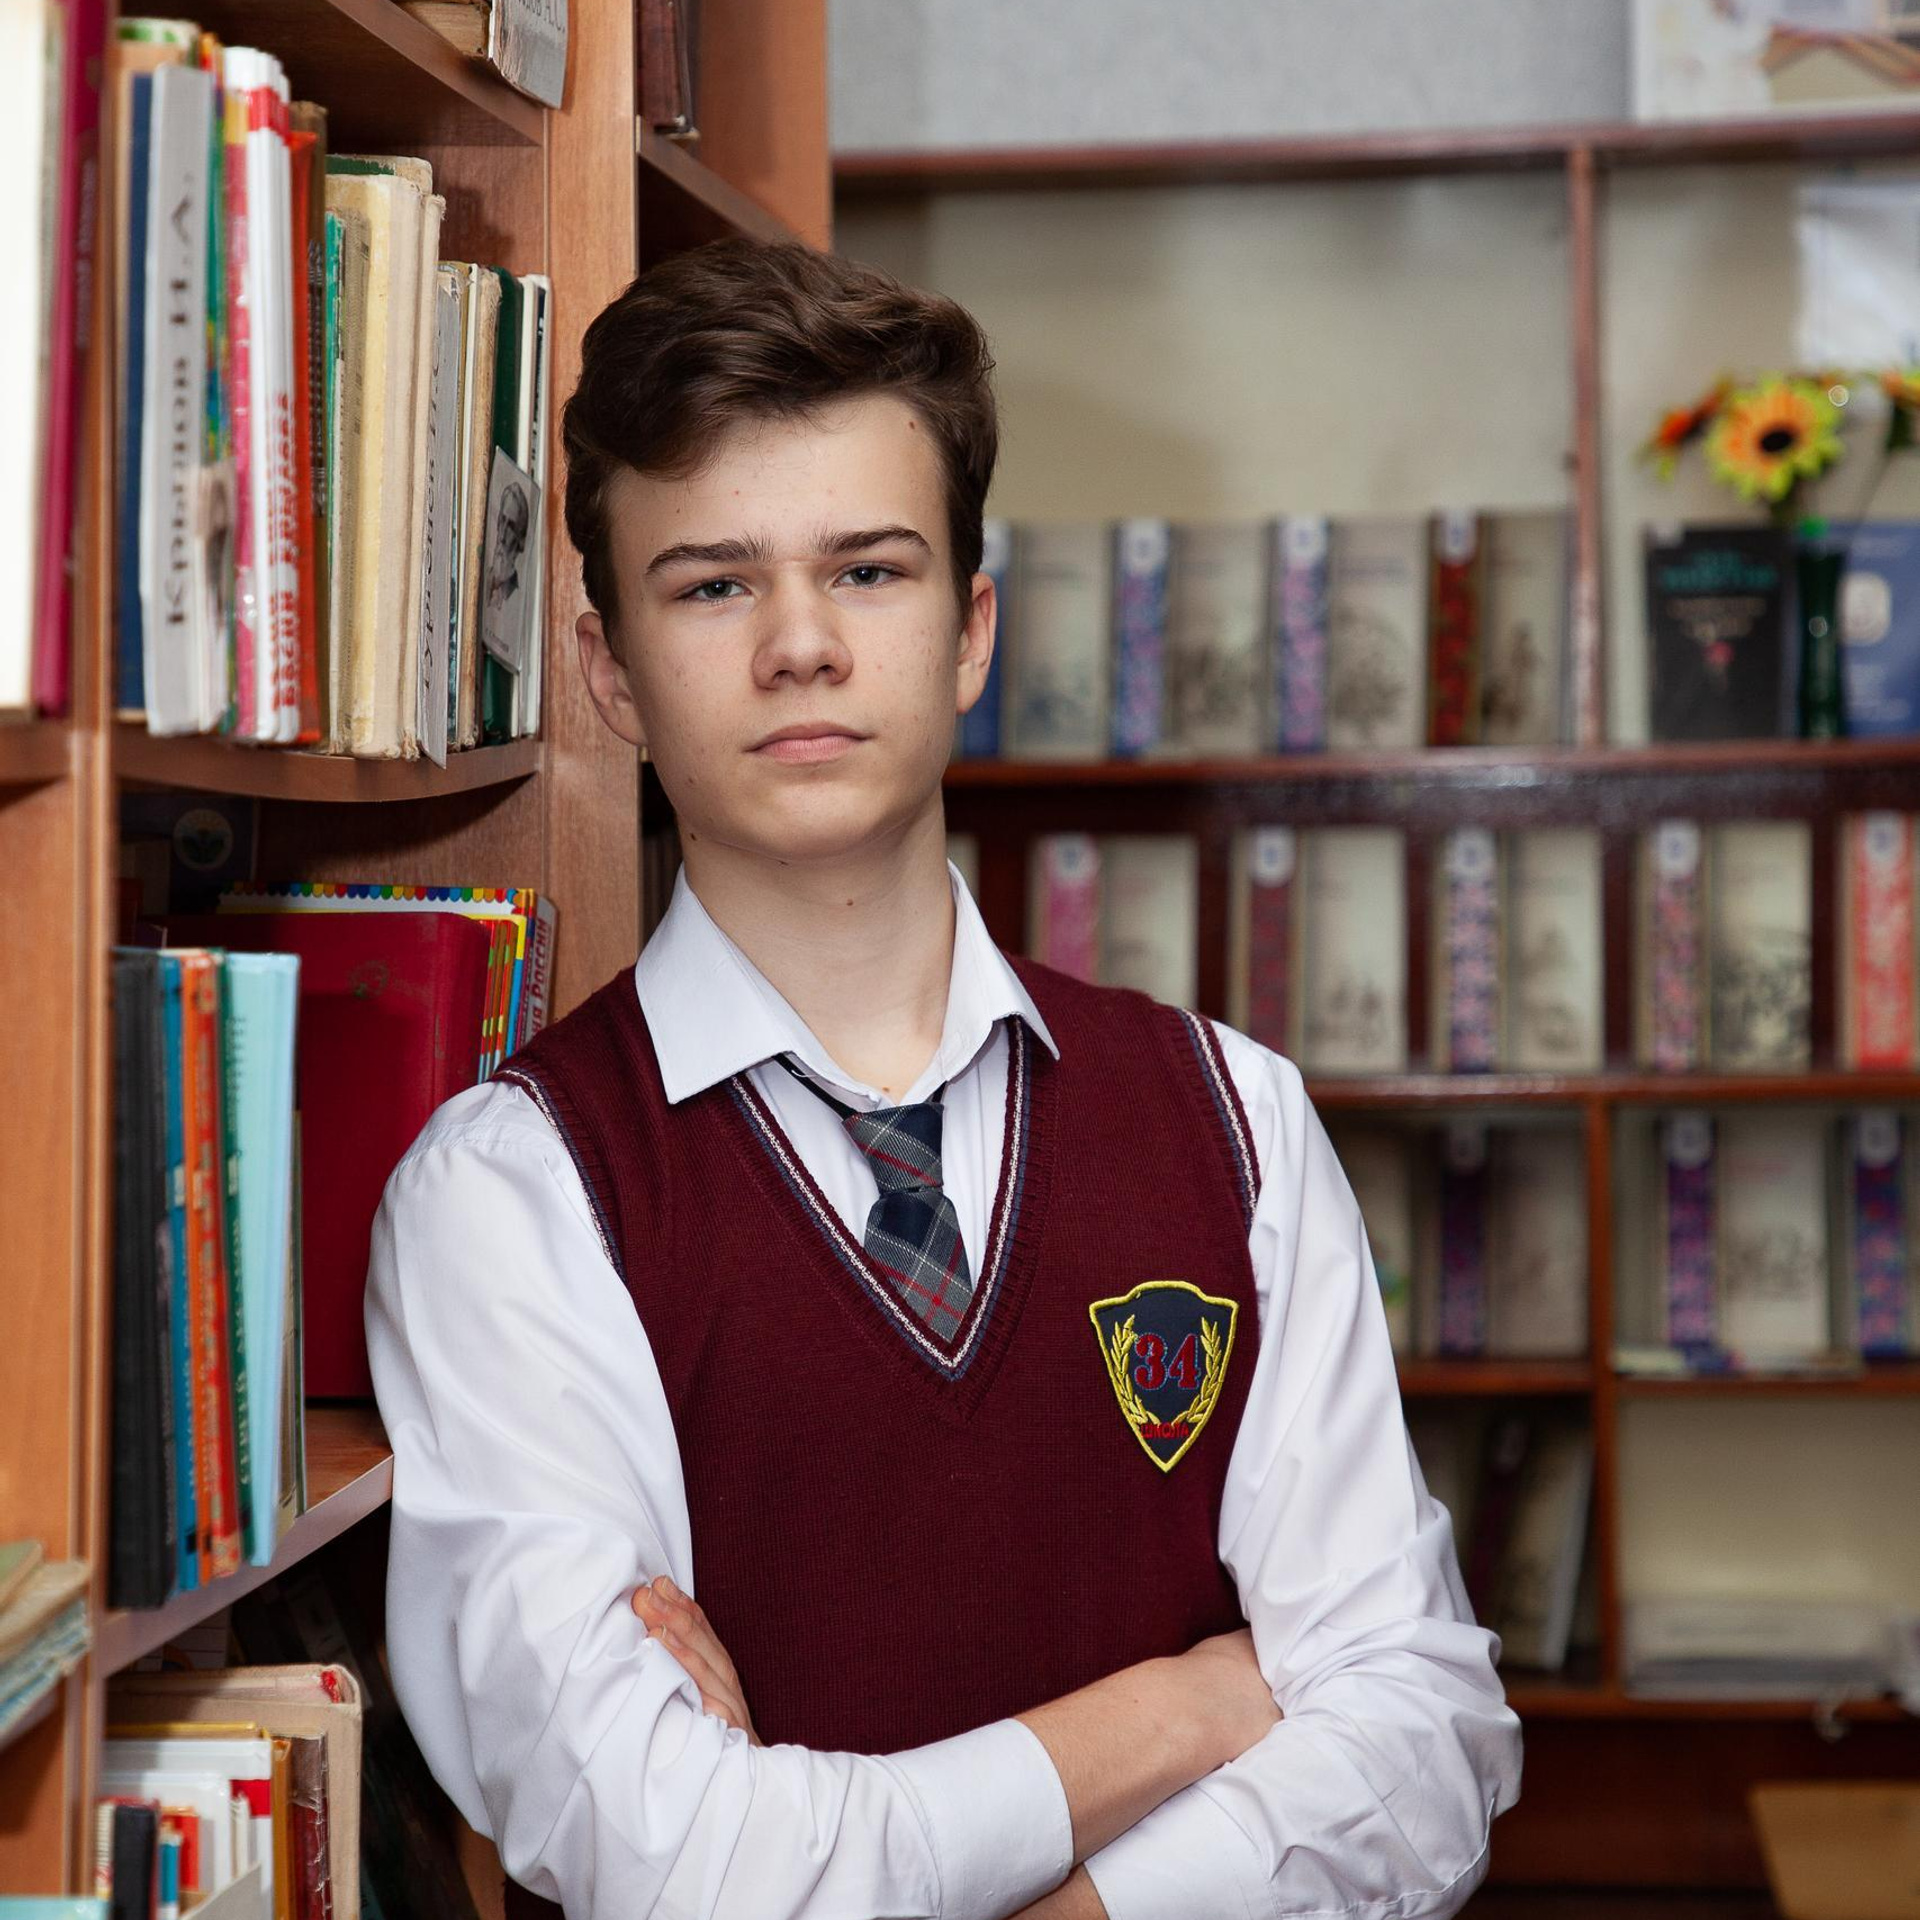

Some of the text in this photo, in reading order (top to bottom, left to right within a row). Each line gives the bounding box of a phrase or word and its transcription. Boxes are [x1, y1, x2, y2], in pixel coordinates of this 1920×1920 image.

[165, 170, 194, 623] Крылов И.А.
[1135, 1333, 1202, 1390] 34
